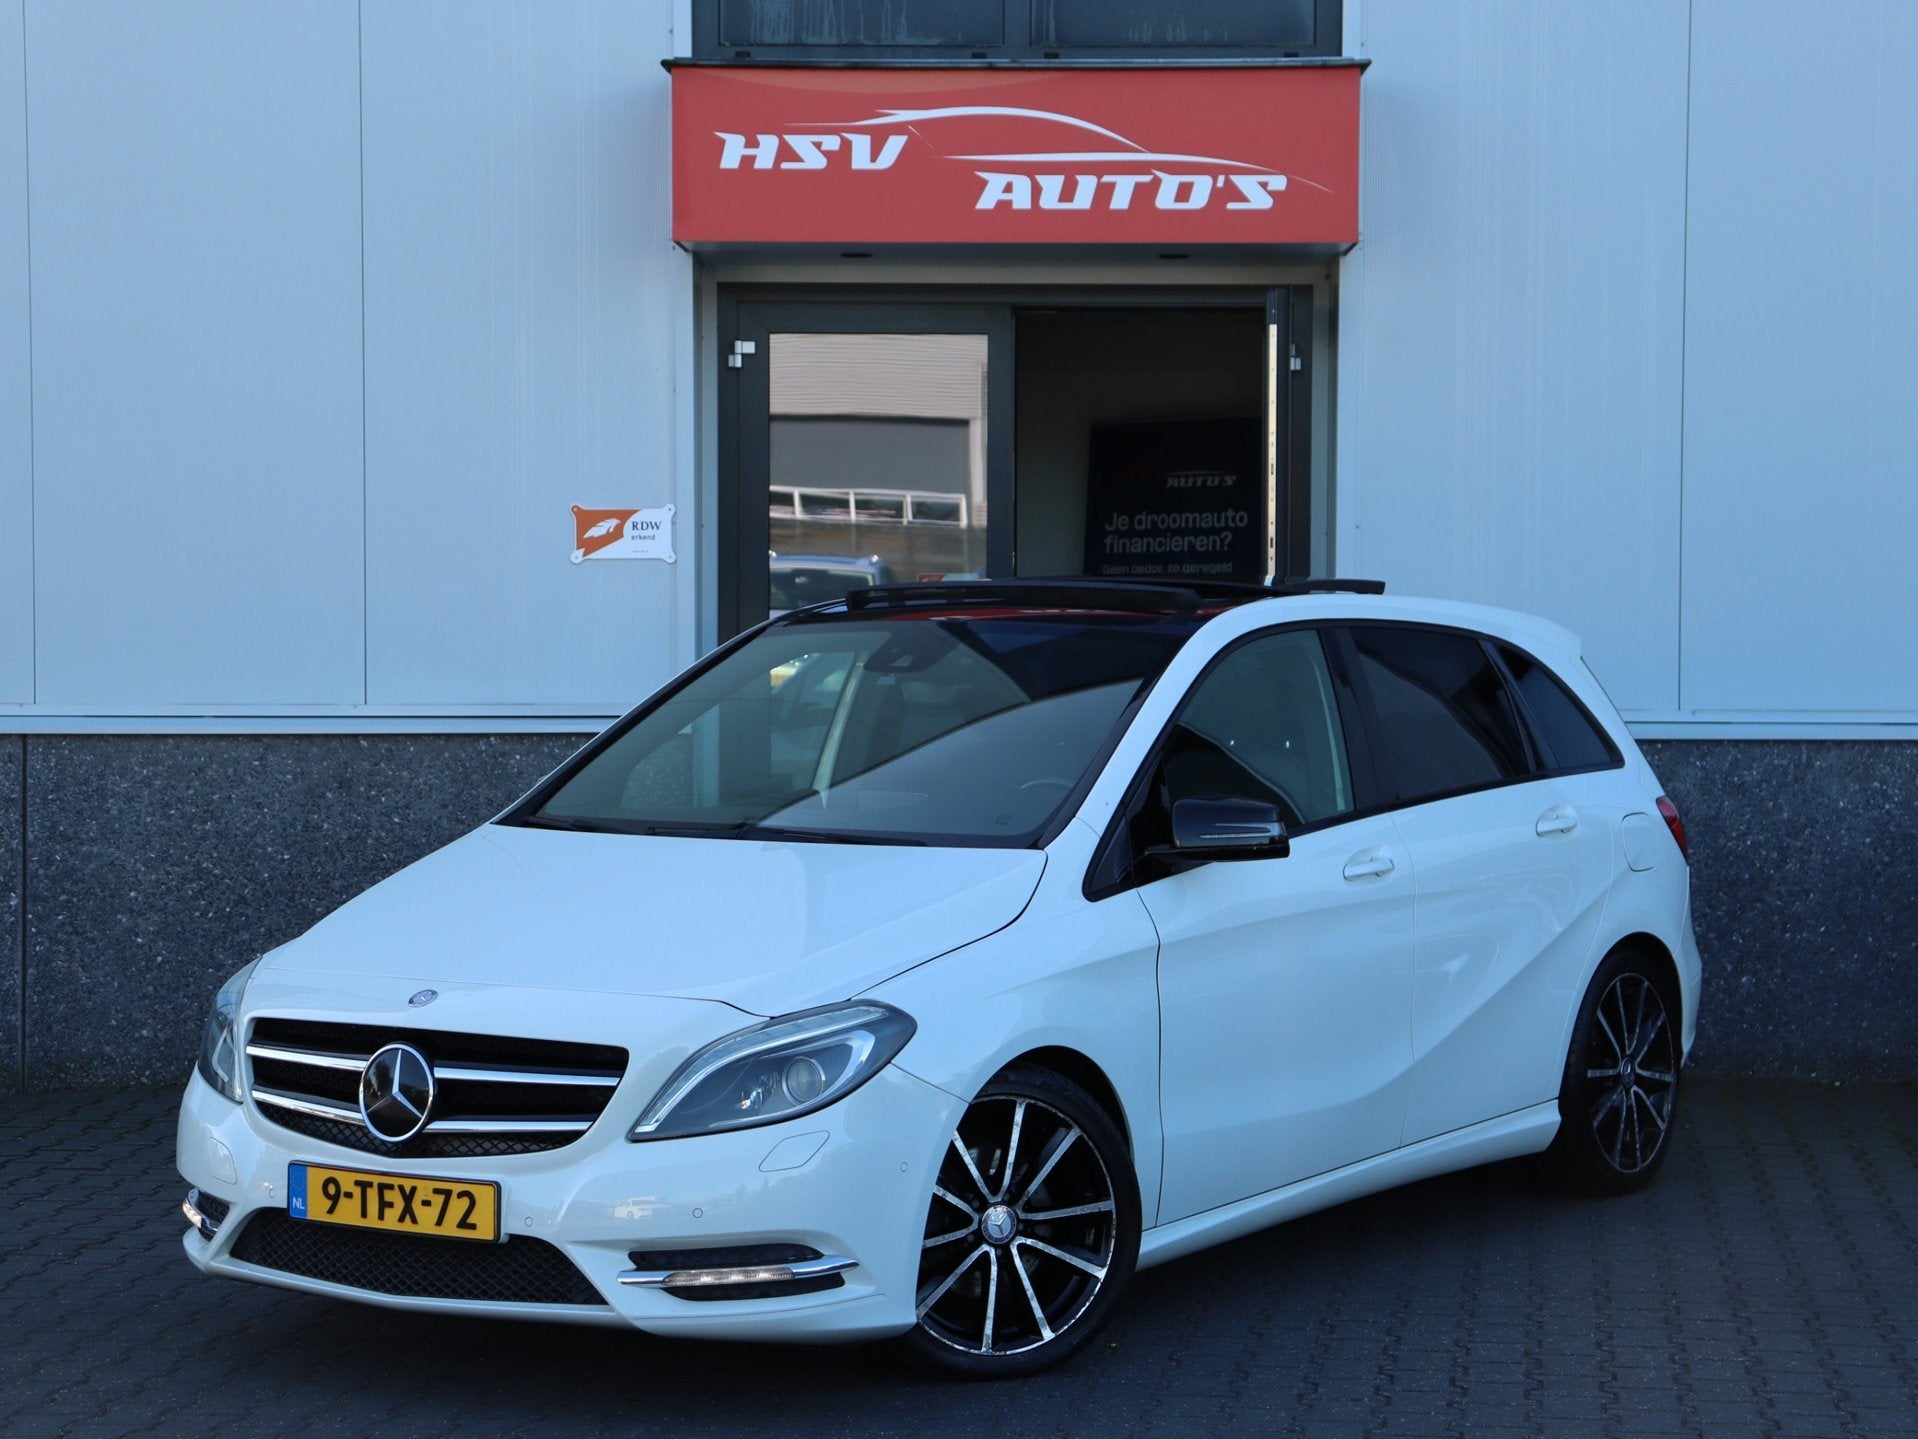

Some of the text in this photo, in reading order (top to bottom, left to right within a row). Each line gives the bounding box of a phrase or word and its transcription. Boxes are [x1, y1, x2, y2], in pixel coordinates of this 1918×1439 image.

[714, 131, 909, 170] HSV
[974, 169, 1288, 210] AUTO'S
[631, 521, 661, 531] RDW
[1104, 507, 1249, 531] Je droomauto
[1103, 531, 1233, 554] financieren?
[1102, 564, 1129, 575] Geen
[1167, 562, 1180, 573] zo
[1182, 561, 1233, 574] geregeld
[292, 1196, 305, 1210] NL
[321, 1176, 478, 1231] 9-TFX-72
